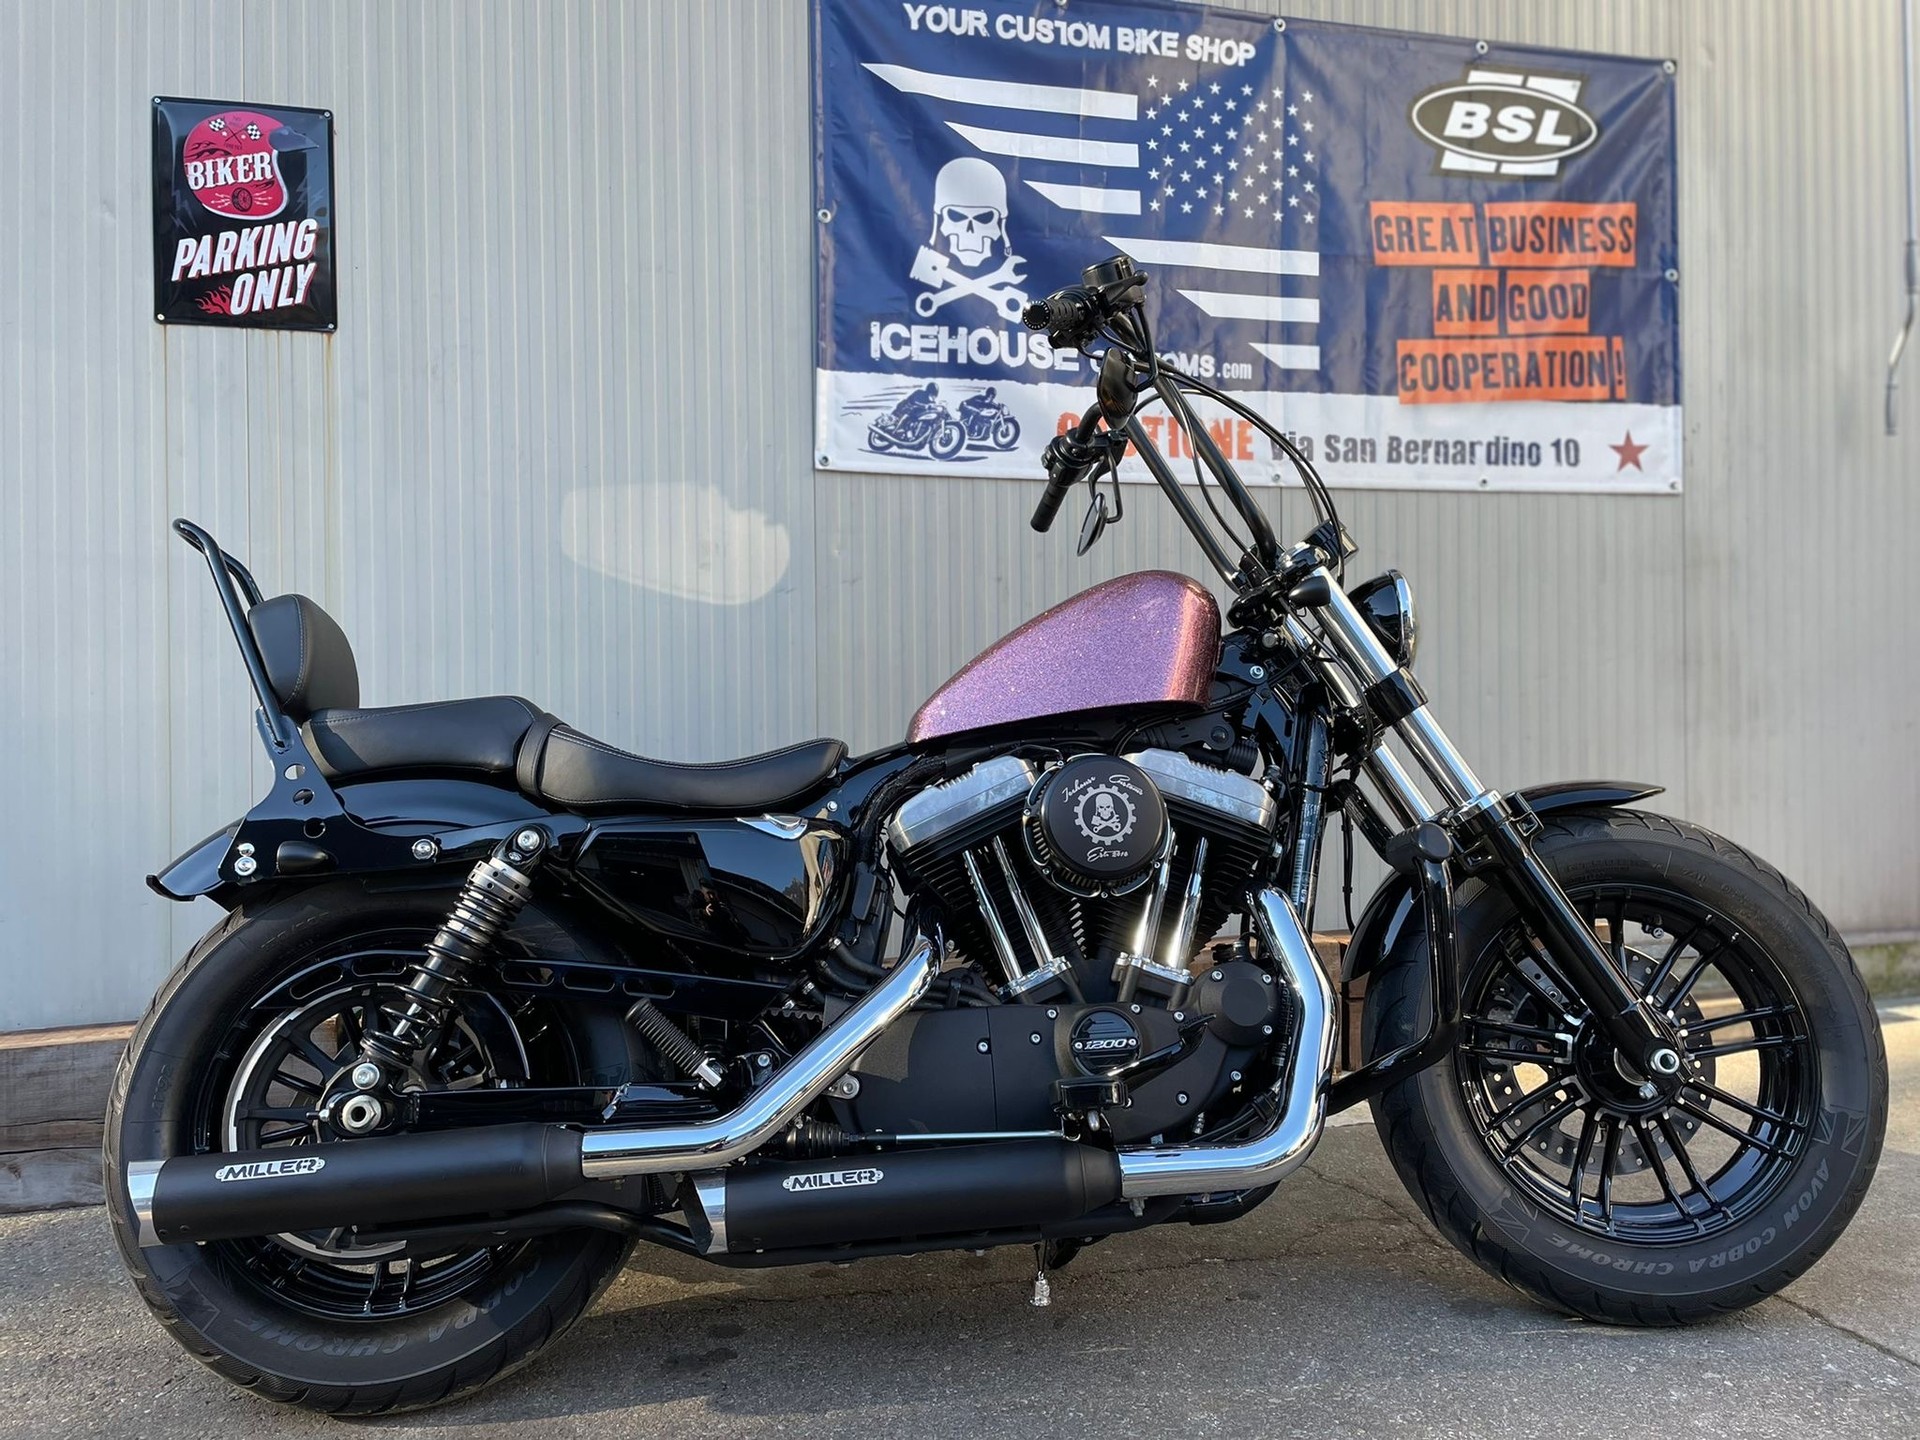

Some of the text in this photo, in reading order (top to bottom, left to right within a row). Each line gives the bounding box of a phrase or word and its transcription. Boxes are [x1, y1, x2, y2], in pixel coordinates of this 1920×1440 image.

[903, 3, 1256, 66] YOUR CUSTOM BIKE SHOP
[1443, 101, 1572, 146] BSL
[185, 151, 274, 190] BIKER
[171, 218, 319, 281] PARKING
[1374, 215, 1634, 253] GREAT BUSINESS
[230, 262, 317, 315] ONLY
[1435, 284, 1588, 322] AND GOOD
[870, 321, 1079, 371] ICEHOUSE
[1325, 434, 1377, 463] San
[1388, 435, 1541, 467] Bernardino
[1551, 438, 1581, 467] 10
[1084, 1038, 1127, 1050] 1200
[224, 1159, 317, 1180] MILLER
[791, 1170, 876, 1190] MILLER
[1545, 1158, 1829, 1276] AVON COBRA CHROME
